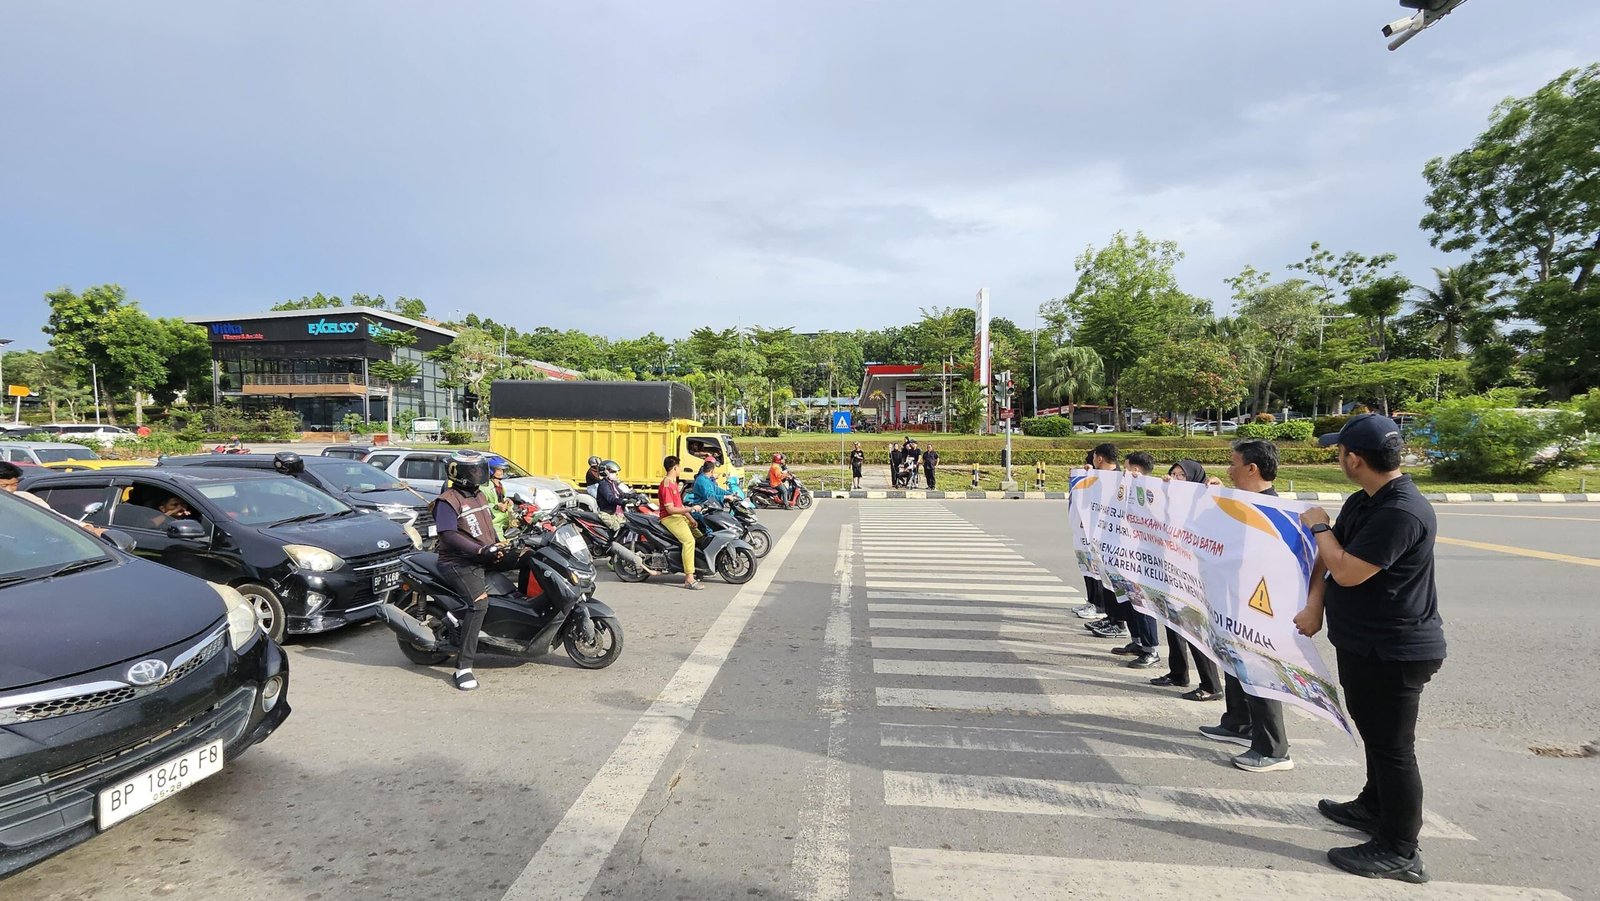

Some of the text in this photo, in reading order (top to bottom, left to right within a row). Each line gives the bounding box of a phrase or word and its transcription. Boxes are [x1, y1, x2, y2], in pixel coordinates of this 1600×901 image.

[308, 318, 356, 336] EXCELSO
[1108, 522, 1114, 533] 3
[1100, 542, 1128, 558] ENJADI
[1128, 548, 1164, 568] KORBAN
[1199, 536, 1225, 557] BATAM
[1109, 556, 1143, 575] KARENA
[1144, 566, 1185, 592] KELUARGA
[1225, 616, 1277, 652] RUMAH
[111, 783, 135, 812] BP
[147, 758, 189, 793] 1846
